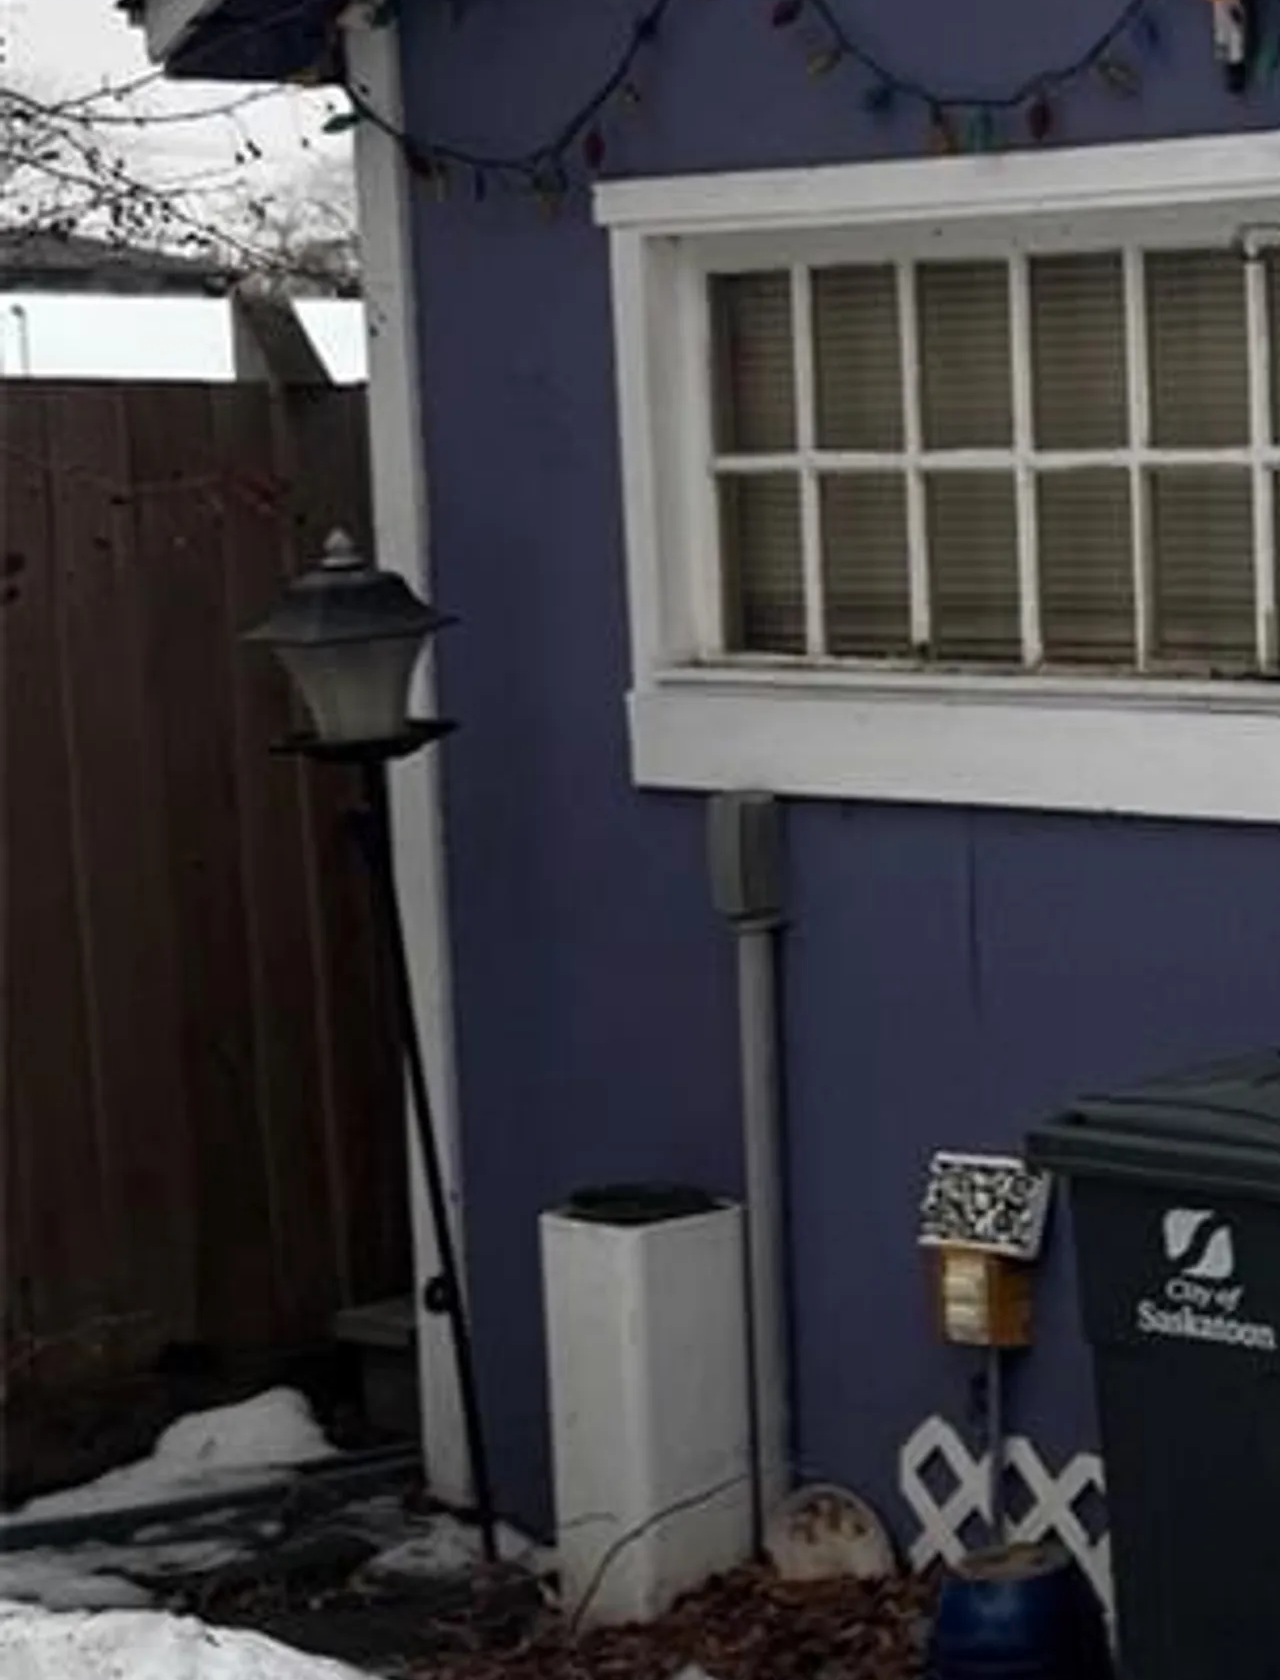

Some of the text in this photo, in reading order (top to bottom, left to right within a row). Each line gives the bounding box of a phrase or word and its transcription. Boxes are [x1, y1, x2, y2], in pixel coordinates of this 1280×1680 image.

[1165, 1278, 1245, 1312] City of
[1137, 1299, 1278, 1351] Saskatoon
